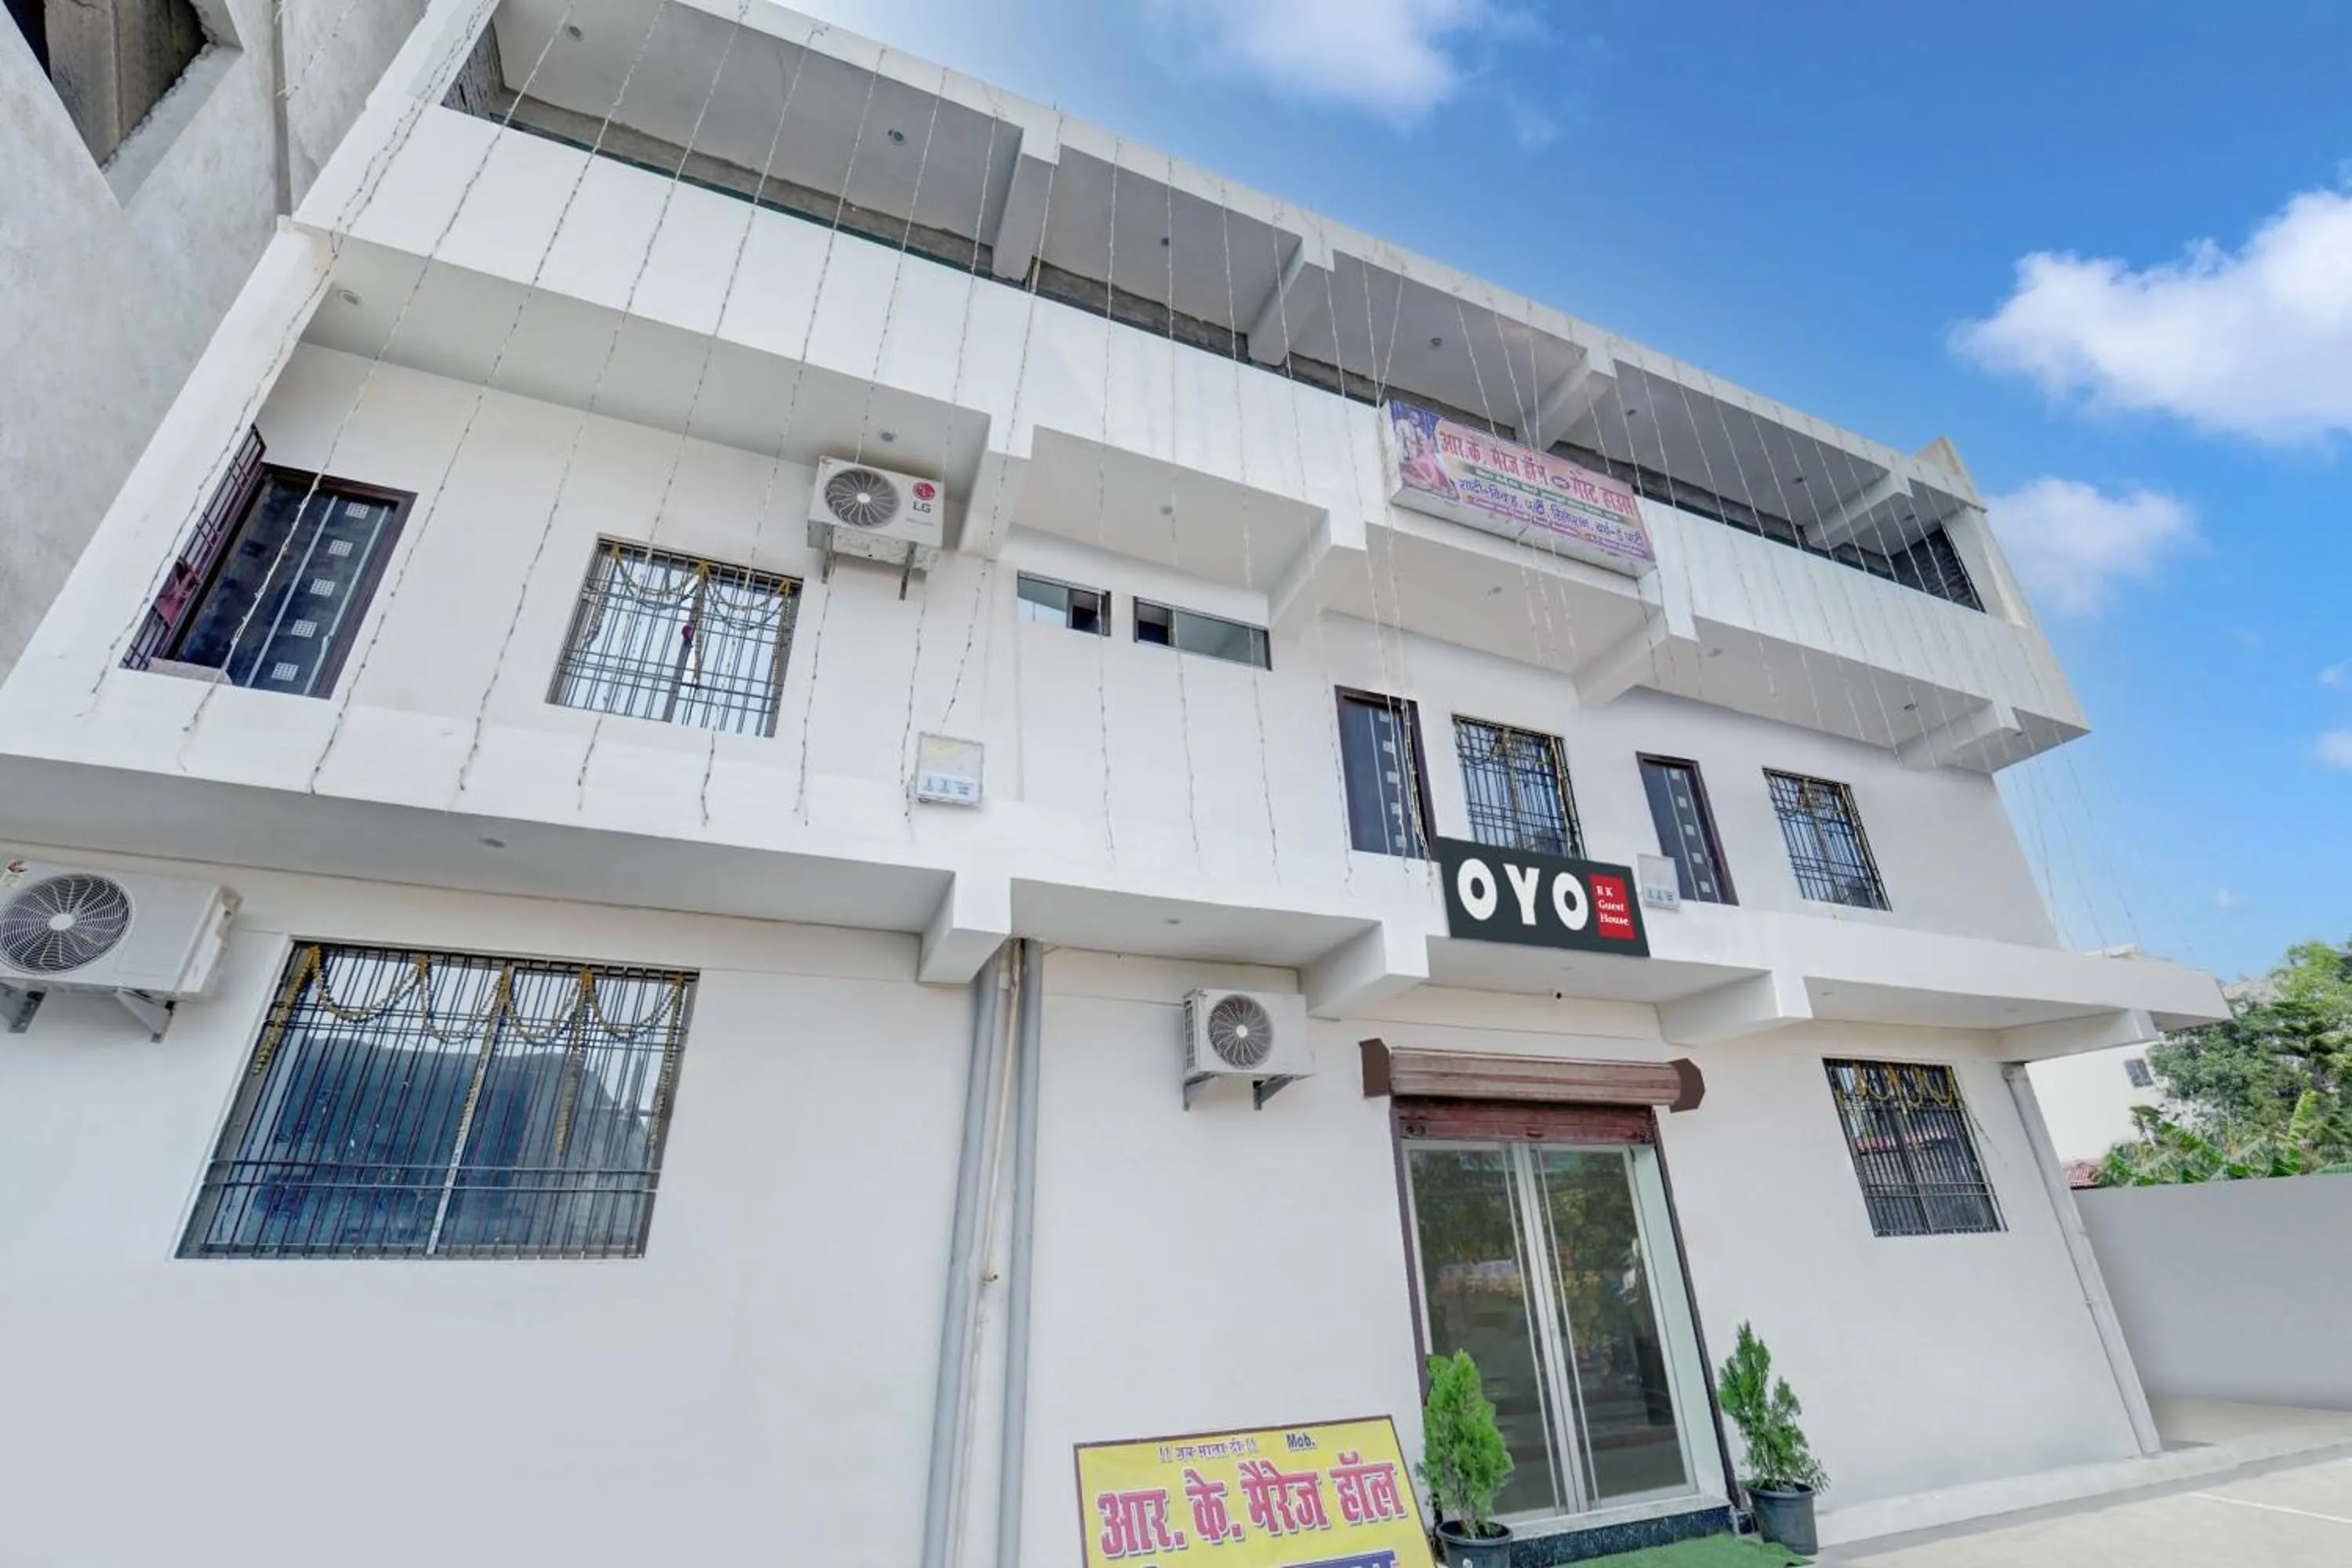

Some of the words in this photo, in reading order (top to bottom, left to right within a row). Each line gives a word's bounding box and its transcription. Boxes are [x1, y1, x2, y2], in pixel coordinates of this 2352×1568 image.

[913, 500, 932, 514] LG
[1457, 858, 1588, 930] OYO
[1598, 899, 1624, 912] Guest
[1600, 913, 1629, 925] House
[1286, 1433, 1316, 1450] Mob.
[1098, 1489, 1185, 1557] आर.
[1183, 1468, 1243, 1542] के.
[1237, 1461, 1328, 1534] मैरेज
[1329, 1452, 1406, 1526] हॉल
